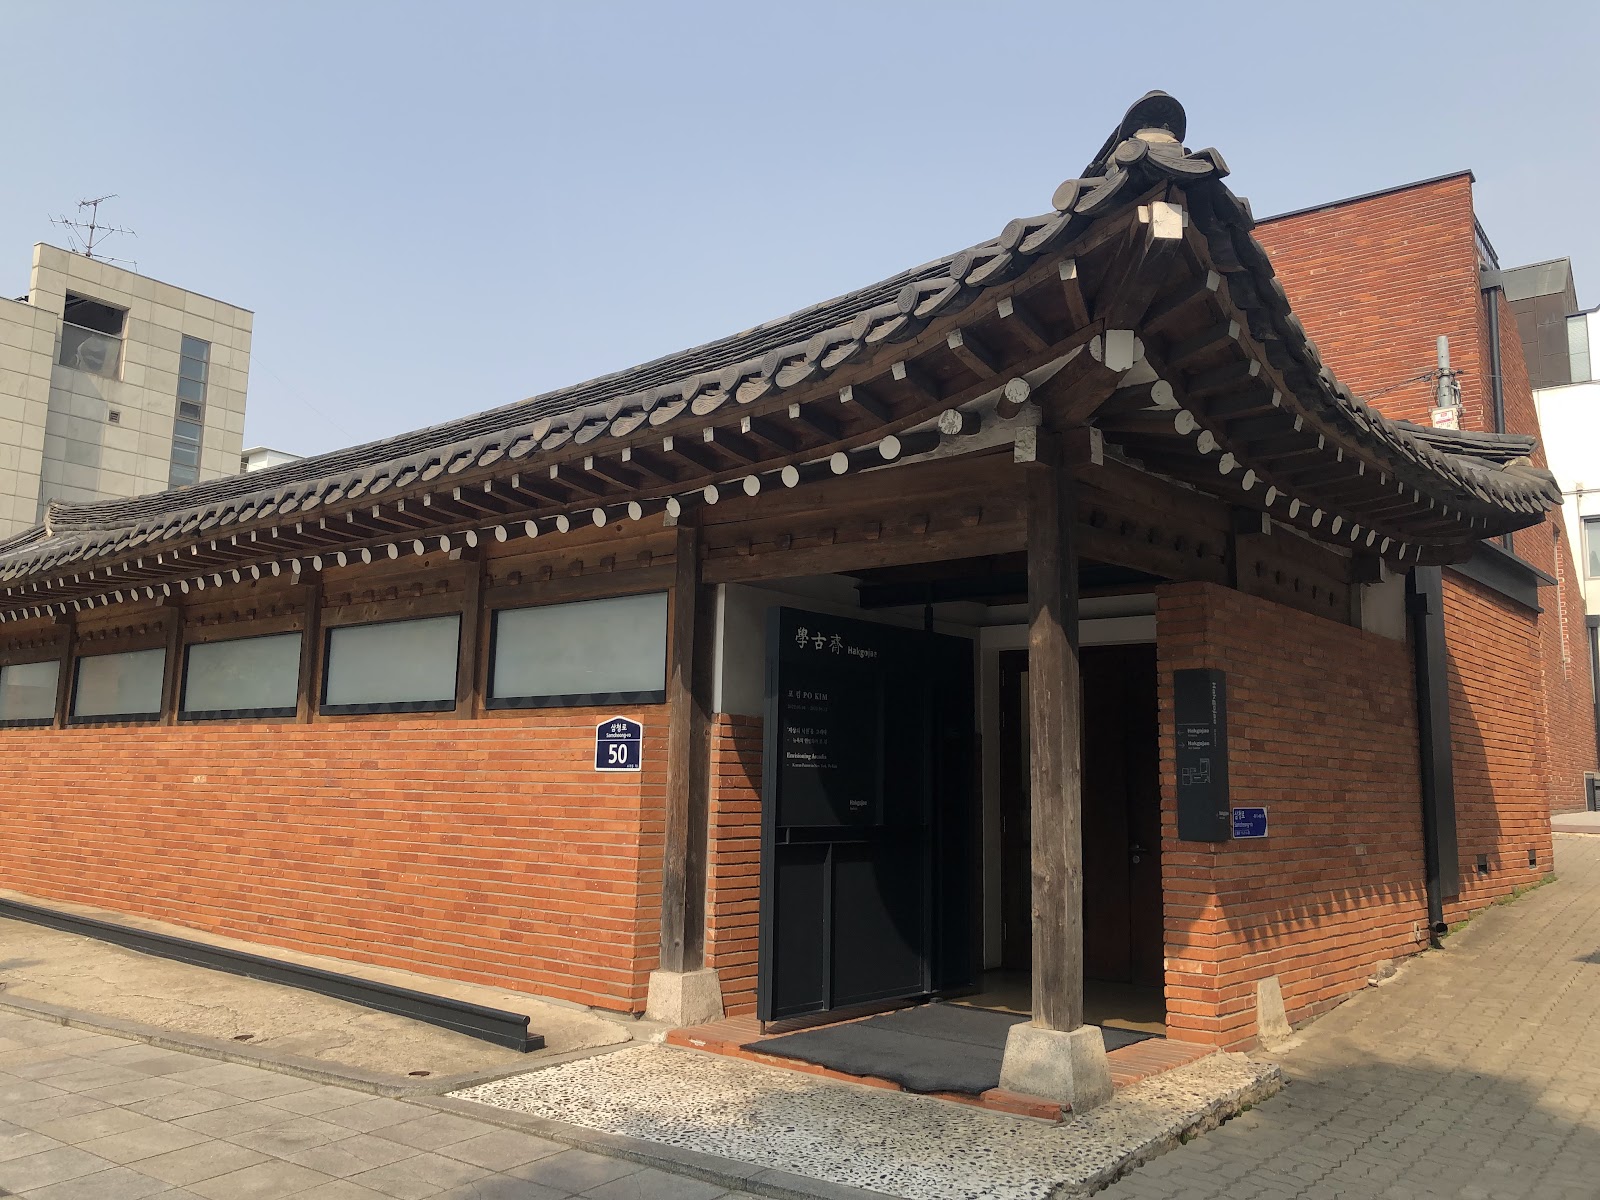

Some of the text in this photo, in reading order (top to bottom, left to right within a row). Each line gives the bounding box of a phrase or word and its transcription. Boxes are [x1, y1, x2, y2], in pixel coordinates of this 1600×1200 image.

[847, 646, 878, 658] Hakgojae
[802, 691, 813, 699] PO
[814, 692, 828, 701] KIM
[611, 723, 627, 732] 삼청로
[608, 743, 628, 764] 50
